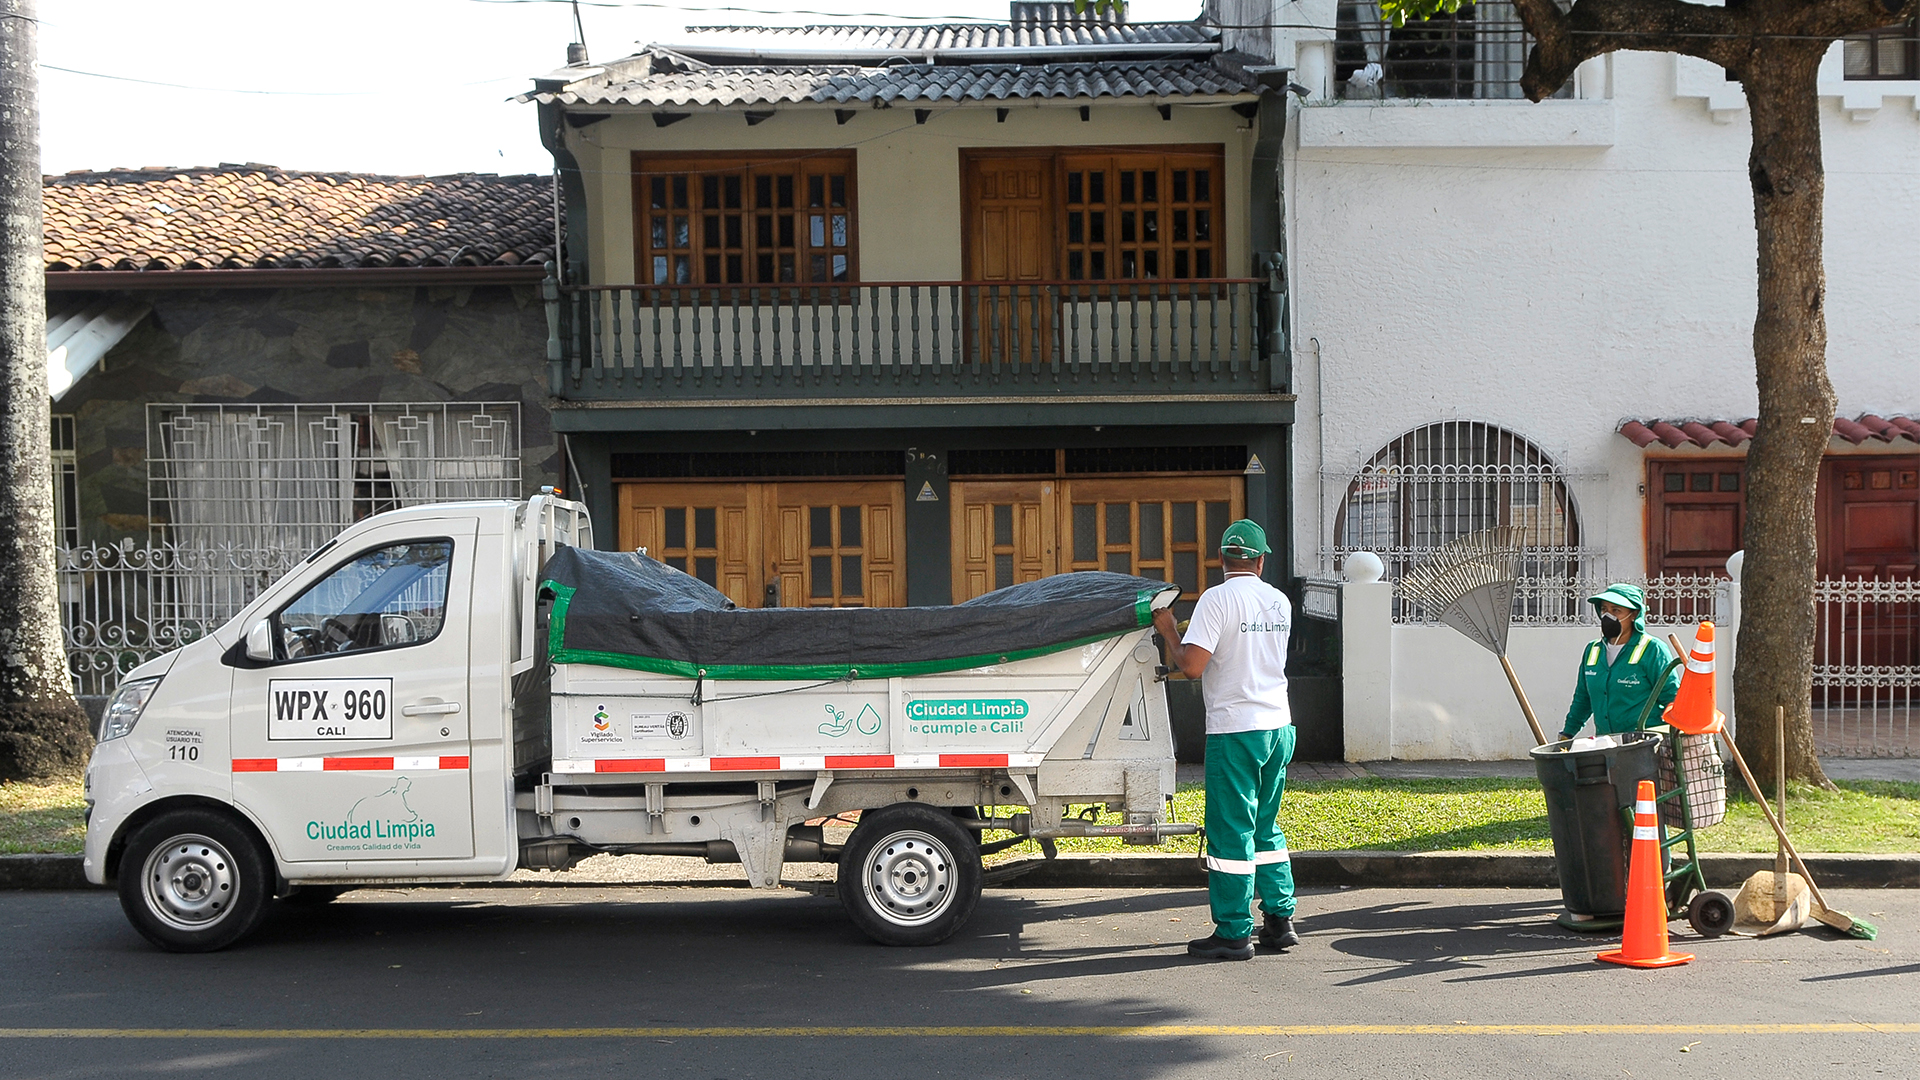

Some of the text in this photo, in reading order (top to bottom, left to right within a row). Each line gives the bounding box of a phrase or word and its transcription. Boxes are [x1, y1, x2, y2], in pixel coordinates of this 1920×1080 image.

[274, 689, 386, 721] WPX 960
[972, 700, 1024, 718] Limpia
[316, 726, 346, 737] CALI
[909, 720, 1024, 736] le cumple a Cali!
[168, 745, 199, 761] 110
[306, 819, 436, 842] Ciudad Limpia
[326, 842, 421, 851] Creamos Calidad de Vida
